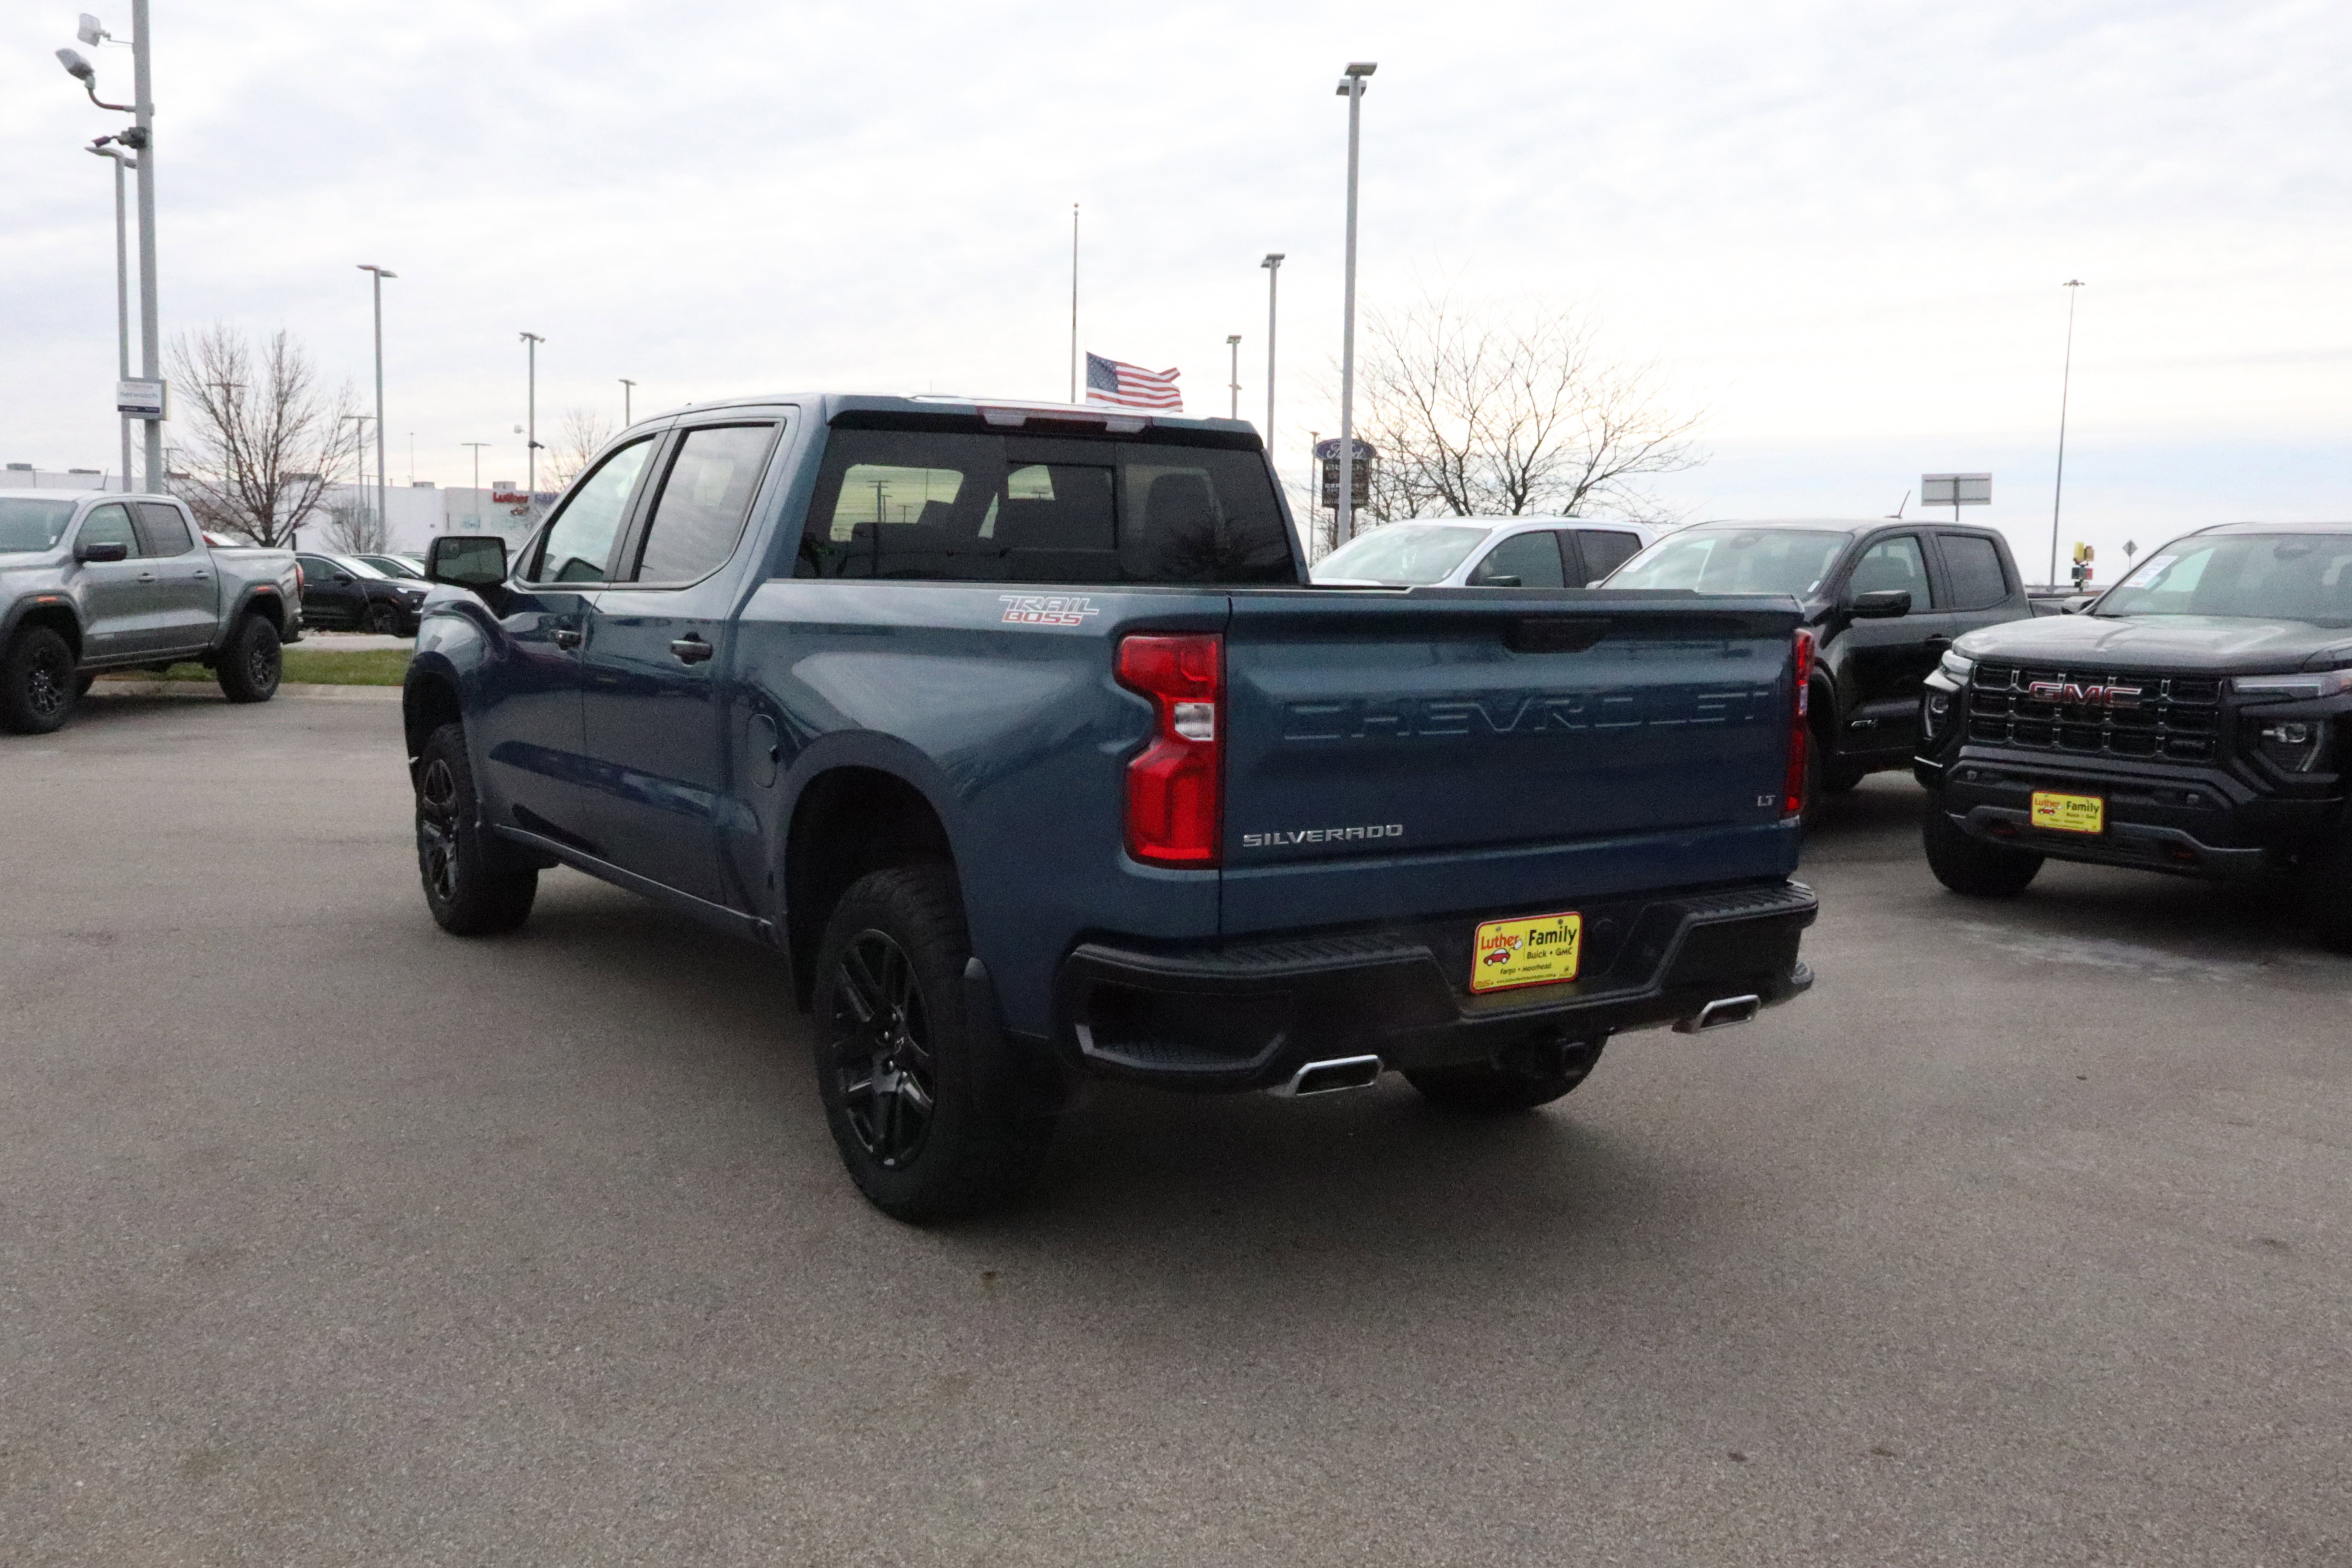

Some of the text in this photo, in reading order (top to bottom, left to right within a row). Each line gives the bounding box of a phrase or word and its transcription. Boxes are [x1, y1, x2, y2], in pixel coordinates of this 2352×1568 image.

[999, 595, 1100, 615] TRAIL
[1002, 610, 1084, 626] BOSS
[2029, 682, 2142, 708] GMC
[1757, 795, 1776, 806] LT
[2035, 798, 2060, 807] Luther
[2067, 800, 2100, 814] Family
[1243, 824, 1403, 847] SILVERADO
[1481, 933, 1519, 950] Luther
[1528, 925, 1577, 946] Family
[1527, 947, 1573, 960] Buick GMC
